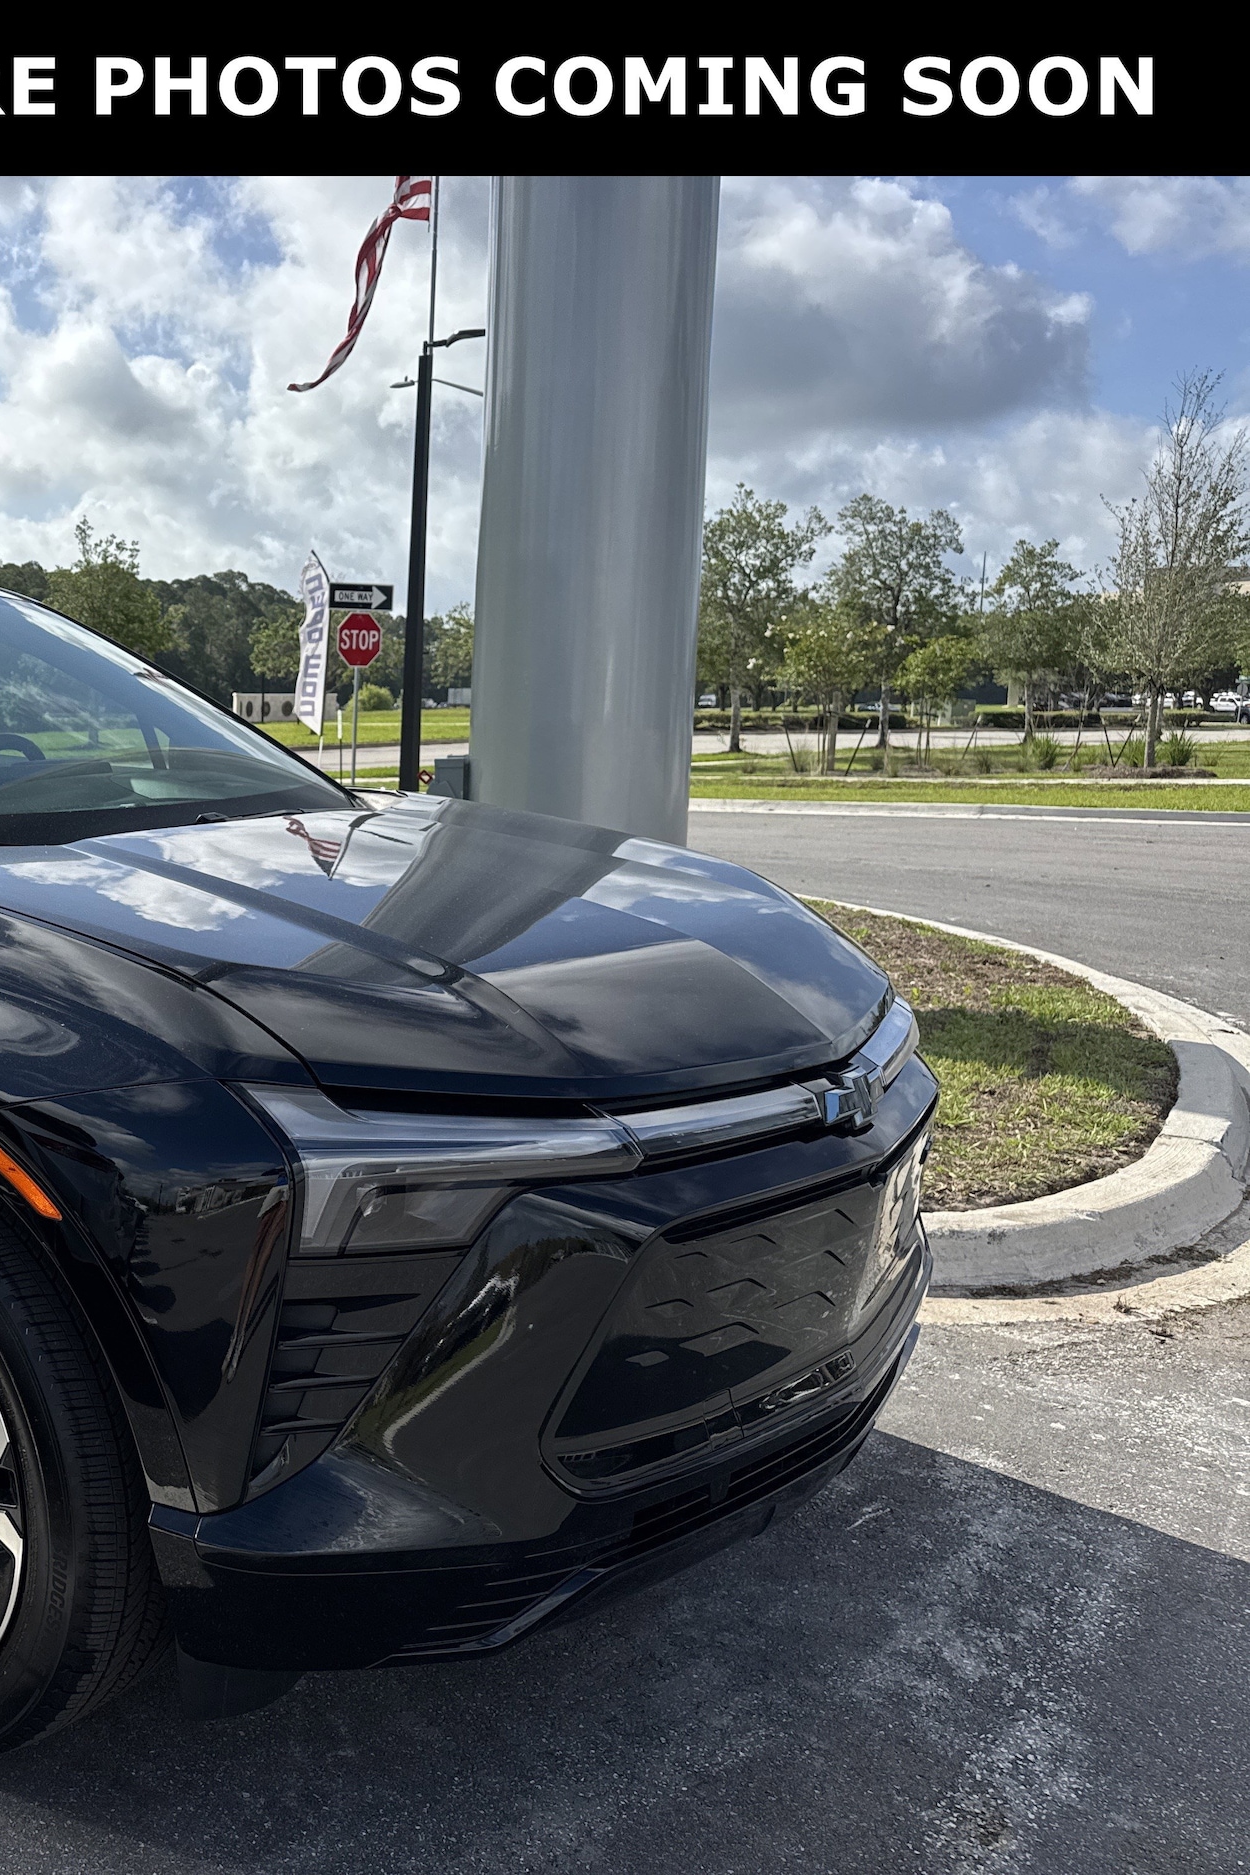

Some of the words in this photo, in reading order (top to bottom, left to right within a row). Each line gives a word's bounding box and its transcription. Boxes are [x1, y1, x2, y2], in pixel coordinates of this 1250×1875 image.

[338, 590, 355, 601] ONE
[357, 591, 373, 601] WAY
[340, 629, 379, 650] STOP
